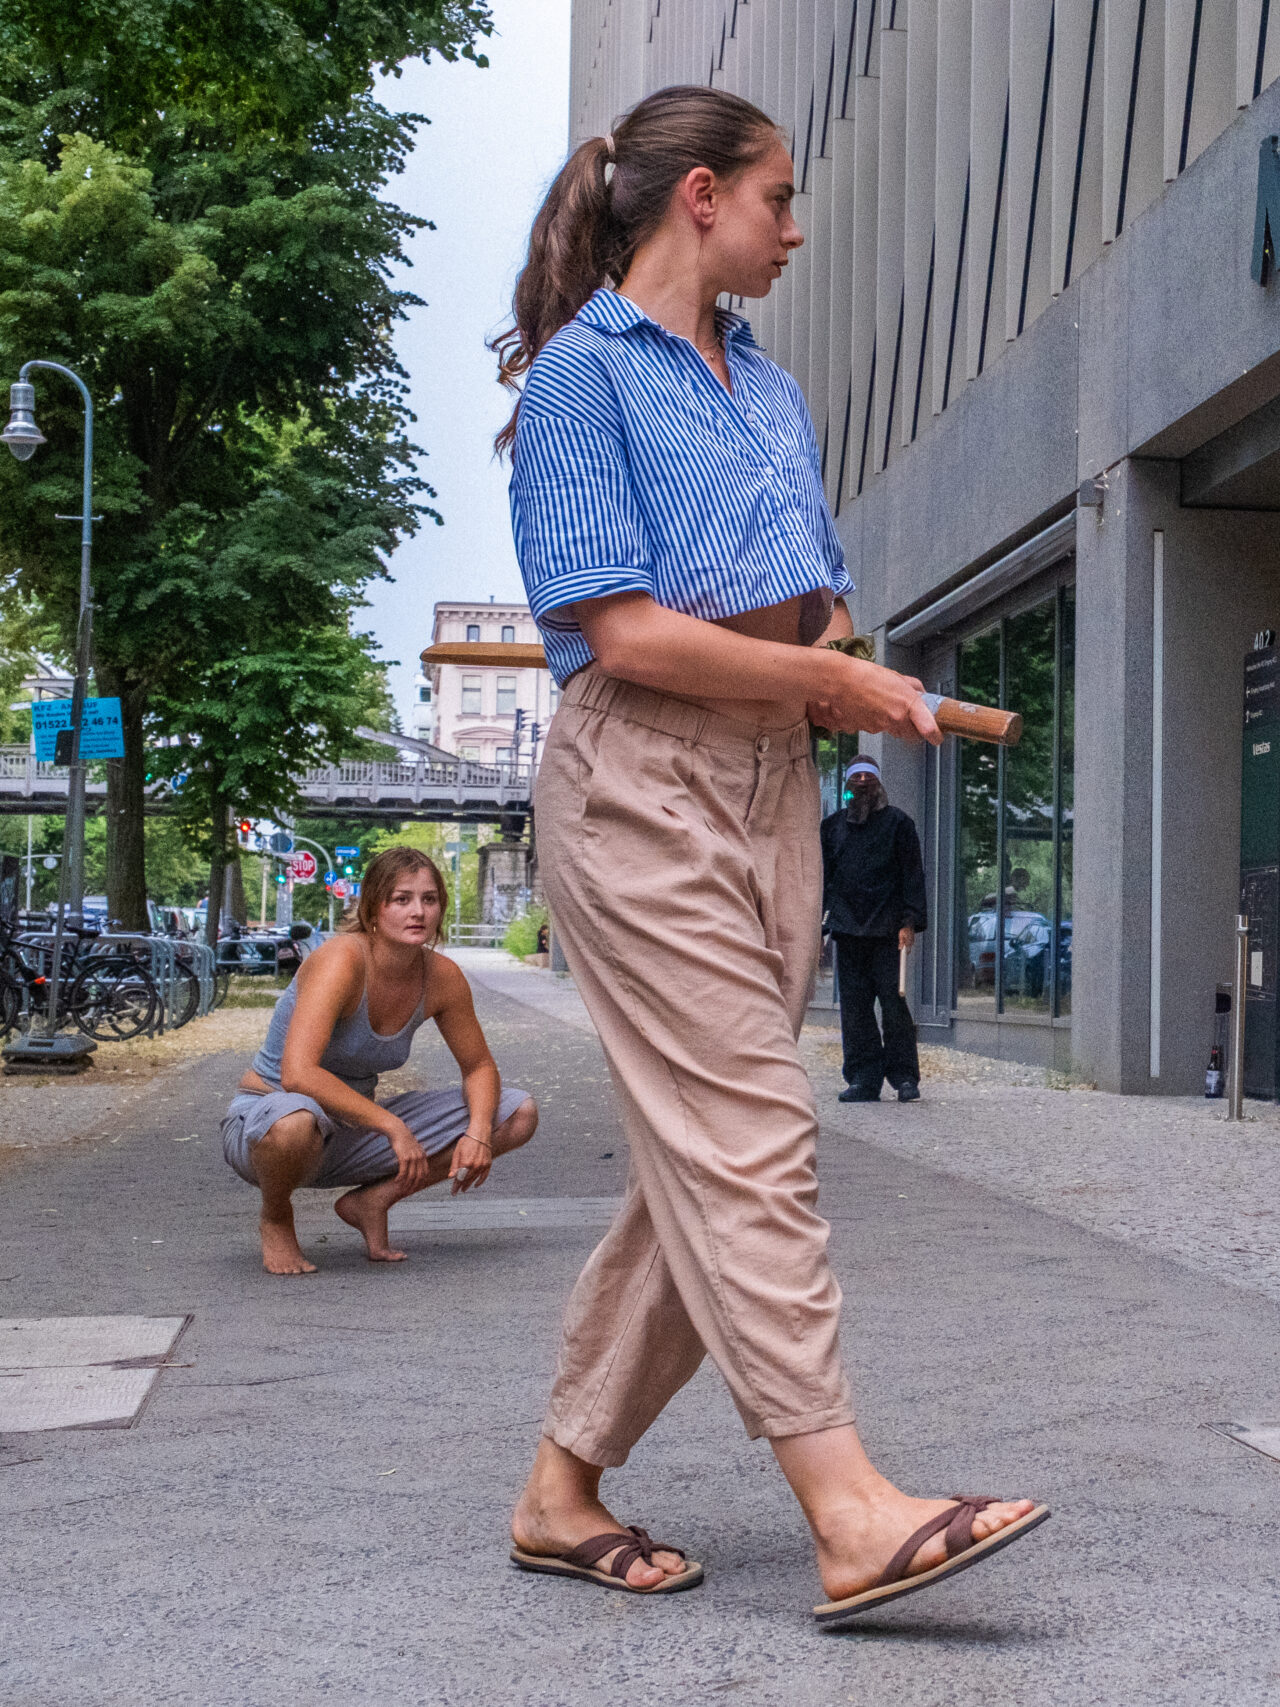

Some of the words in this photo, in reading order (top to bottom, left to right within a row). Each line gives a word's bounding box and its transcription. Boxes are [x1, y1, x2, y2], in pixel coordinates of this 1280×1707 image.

[35, 719, 67, 730] 01522
[92, 717, 104, 726] 46
[106, 716, 118, 725] 74
[292, 860, 313, 870] STOP
